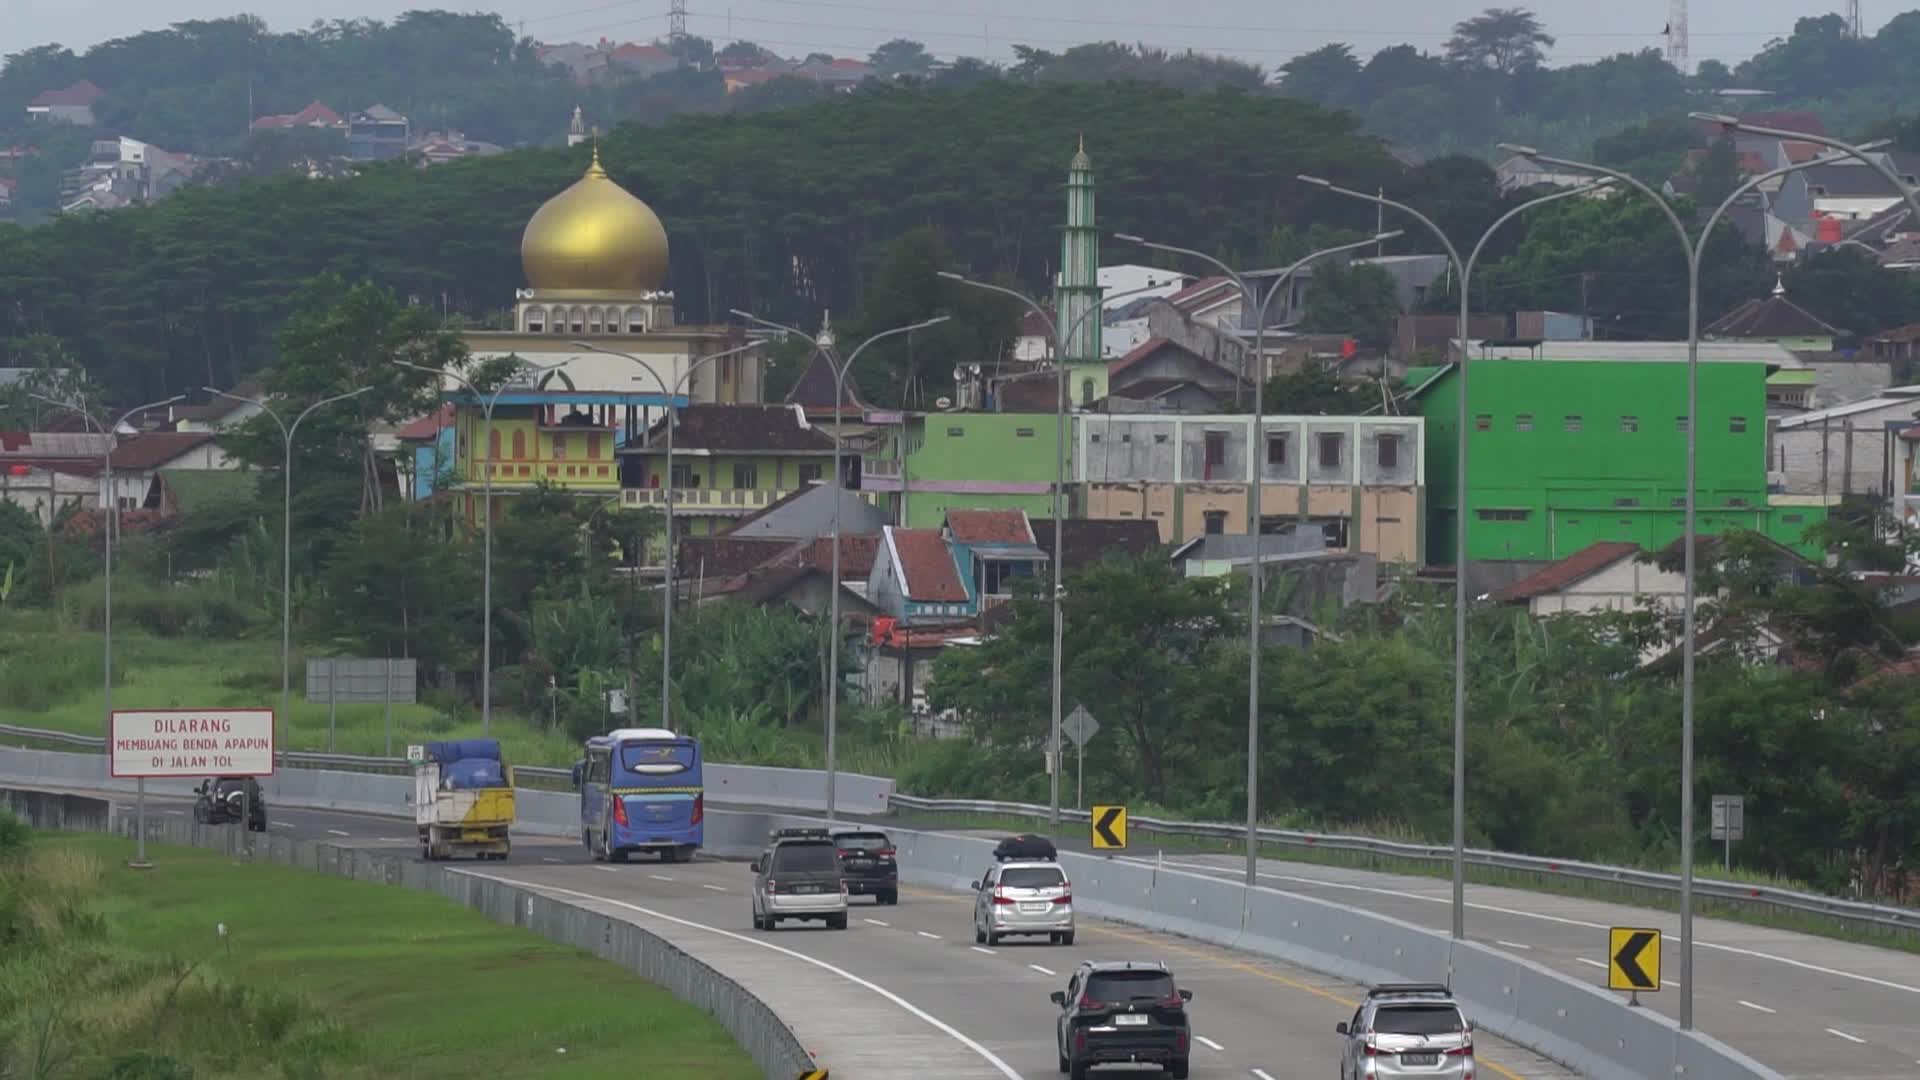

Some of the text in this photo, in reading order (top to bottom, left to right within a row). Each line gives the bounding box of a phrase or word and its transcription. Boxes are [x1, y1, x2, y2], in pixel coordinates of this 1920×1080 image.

[154, 719, 231, 733] DILARANG
[117, 738, 269, 751] MEMBUANG BENDA APAPUN
[152, 755, 233, 768] DI JALAN TOL
